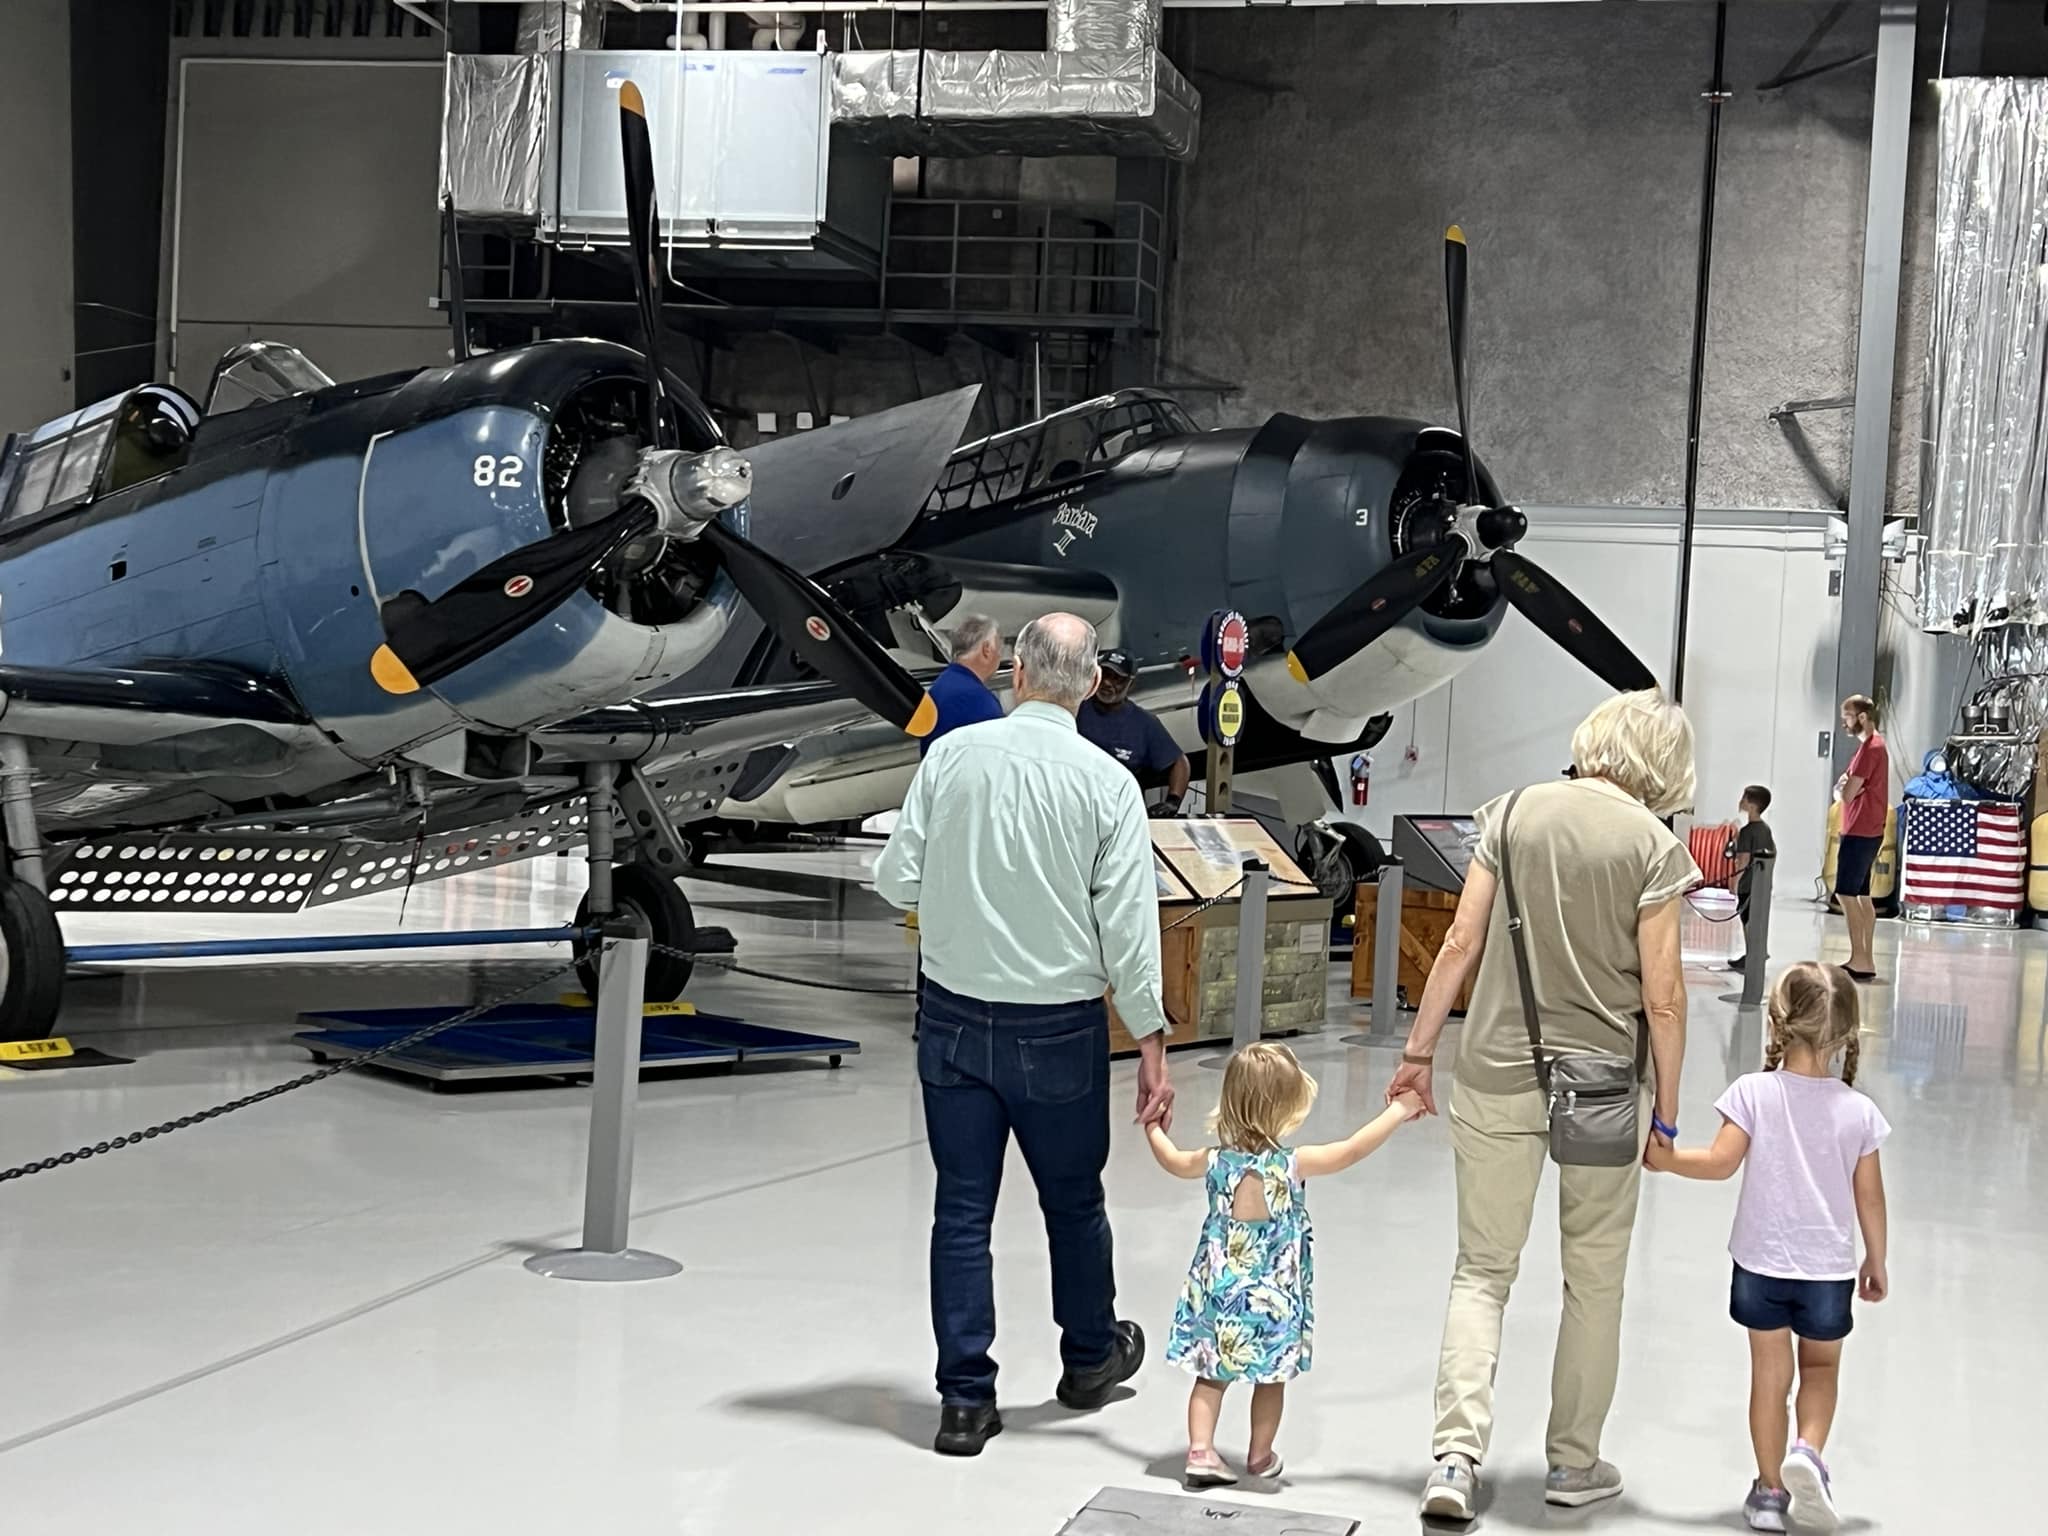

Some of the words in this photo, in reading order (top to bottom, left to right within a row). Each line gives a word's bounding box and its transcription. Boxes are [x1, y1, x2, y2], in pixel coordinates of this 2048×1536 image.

[474, 455, 523, 487] 82
[1052, 502, 1098, 538] Barbara
[1356, 509, 1368, 526] 3
